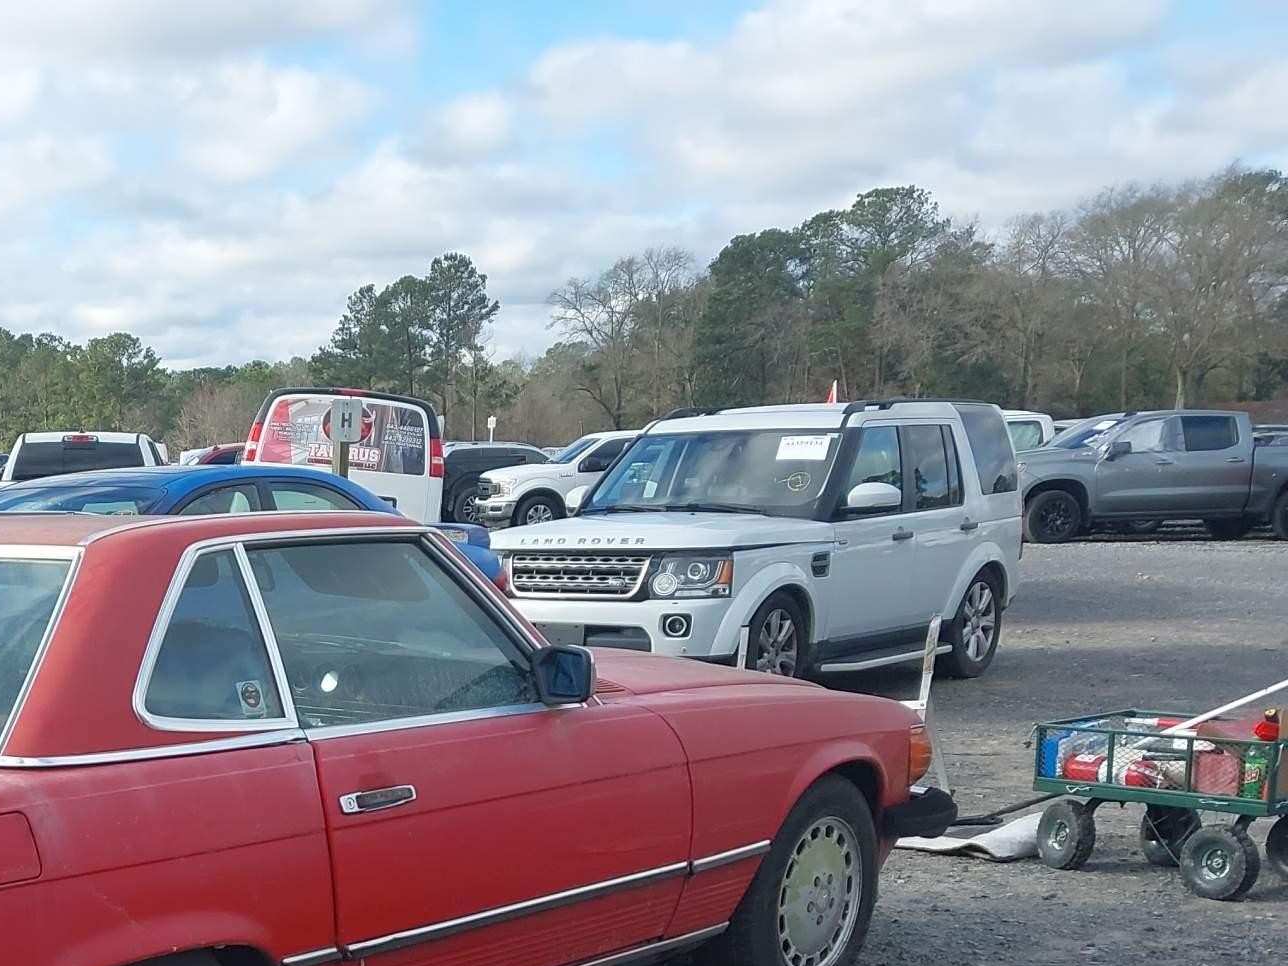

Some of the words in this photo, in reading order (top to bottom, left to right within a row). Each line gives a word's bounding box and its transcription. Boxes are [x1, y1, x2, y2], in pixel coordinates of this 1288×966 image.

[341, 412, 353, 429] H
[308, 444, 381, 462] TARUS
[520, 537, 567, 545] LAND
[577, 537, 646, 545] ROVER
